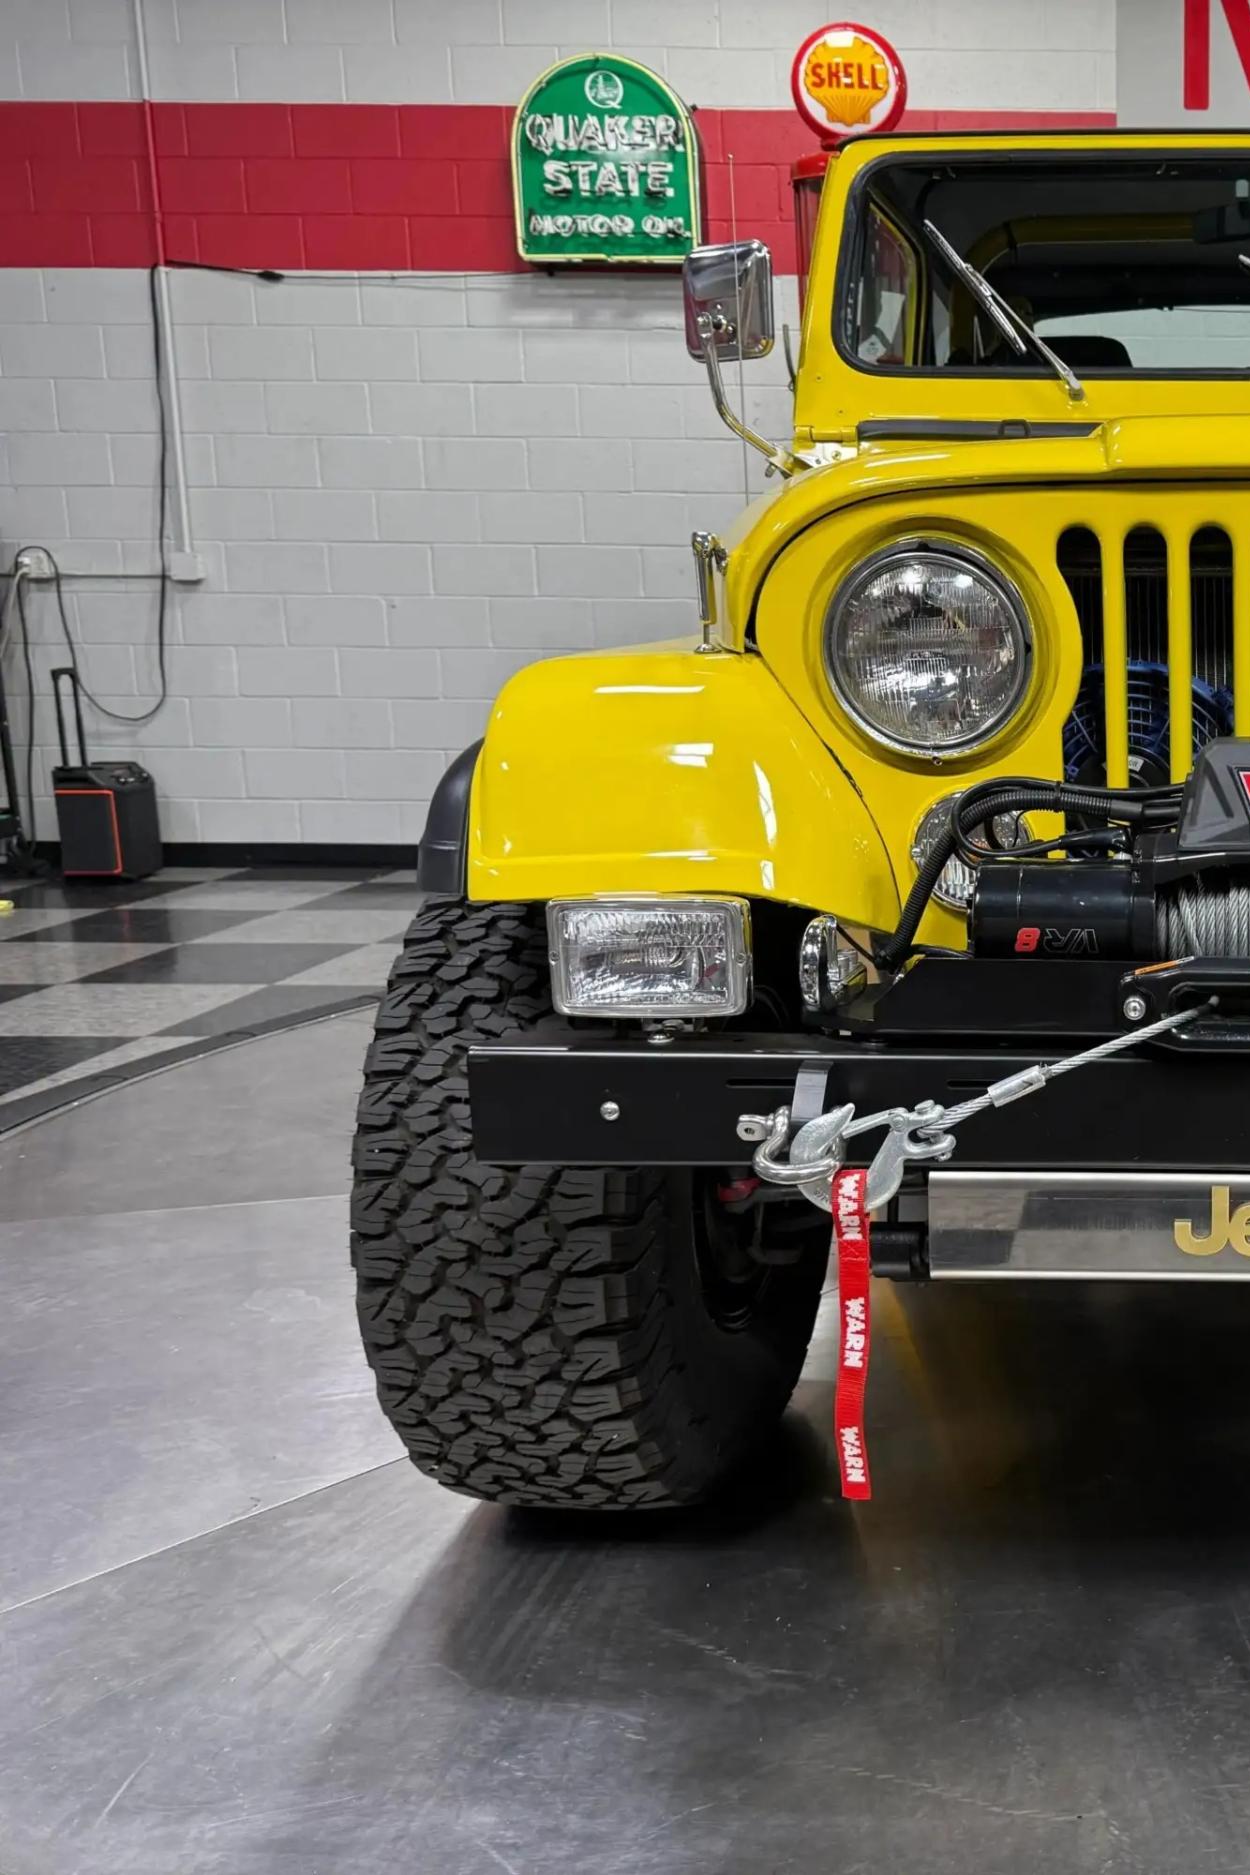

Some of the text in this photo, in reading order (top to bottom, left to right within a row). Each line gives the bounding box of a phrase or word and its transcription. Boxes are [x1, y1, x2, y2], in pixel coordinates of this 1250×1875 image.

[811, 62, 884, 90] SHELL
[525, 113, 685, 154] QUAKER
[543, 160, 675, 197] STATE
[529, 214, 691, 237] MOTOR OIL
[837, 1173, 867, 1483] WARN WARN WARN
